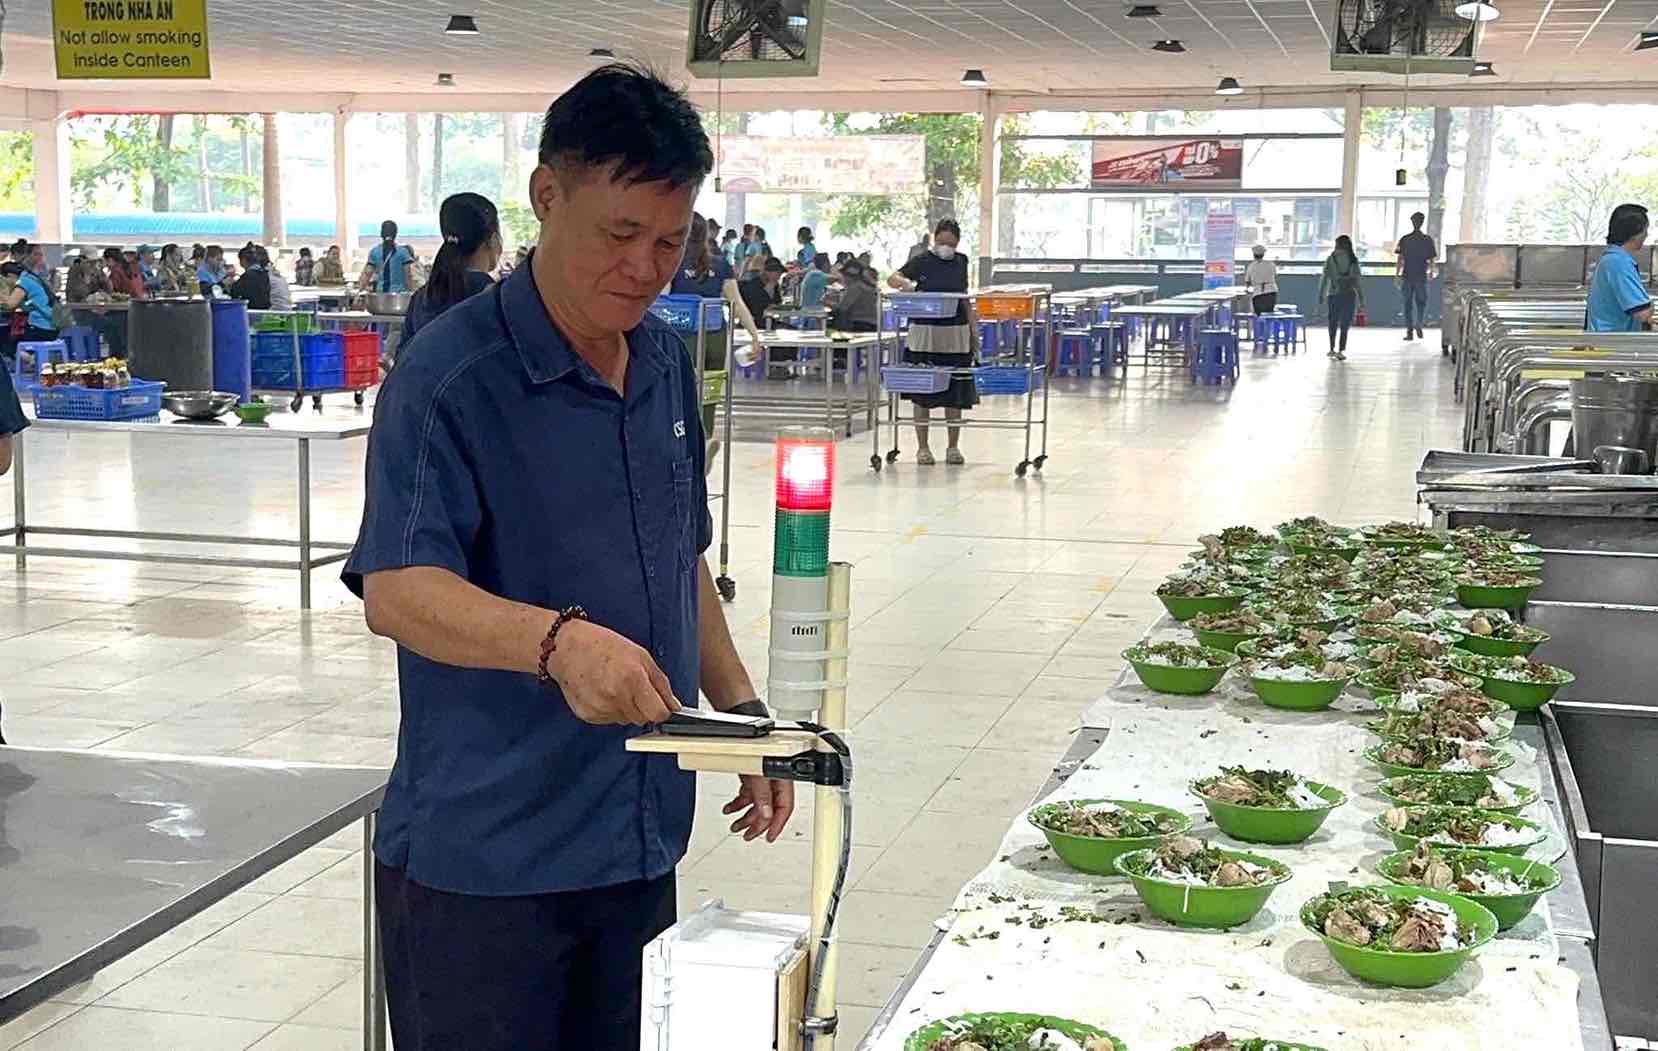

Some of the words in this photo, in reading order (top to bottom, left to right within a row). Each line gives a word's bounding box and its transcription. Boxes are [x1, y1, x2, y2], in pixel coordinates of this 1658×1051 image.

[84, 1, 124, 20] TRONG
[61, 30, 86, 45] Not
[91, 30, 131, 45] allow
[136, 30, 201, 47] smoking
[74, 52, 119, 68] inside
[123, 52, 192, 68] Canteen
